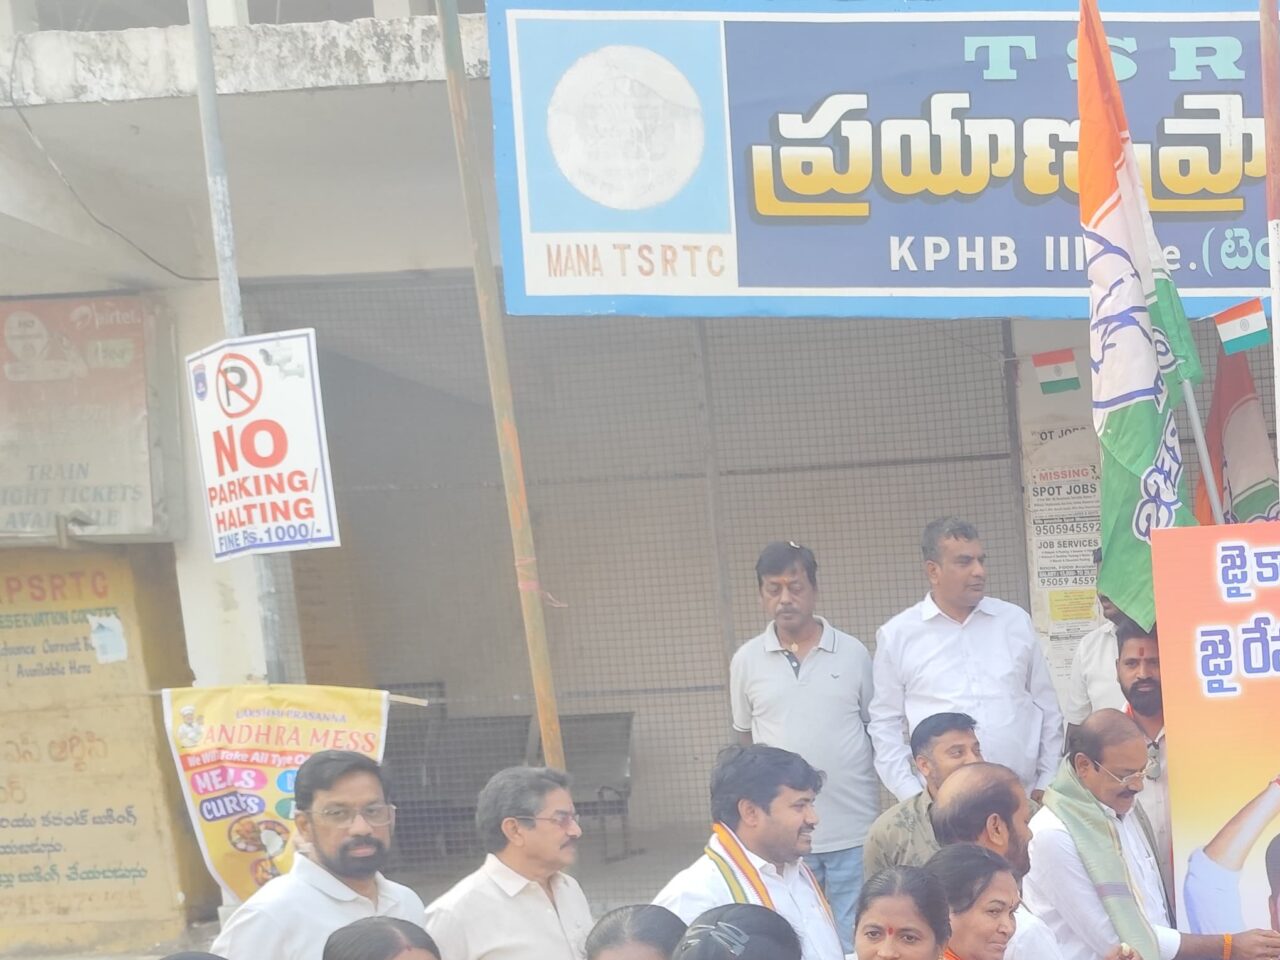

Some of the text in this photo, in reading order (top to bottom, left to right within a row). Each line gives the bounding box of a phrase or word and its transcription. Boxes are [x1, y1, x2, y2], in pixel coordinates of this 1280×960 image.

[546, 242, 725, 278] MANA TSRTC
[889, 236, 1019, 272] KPHB
[212, 419, 288, 478] NO
[27, 462, 90, 481] TRAIN
[1039, 468, 1090, 481] MISSING
[0, 484, 143, 505] IGHT TICKETS
[208, 467, 318, 508] PARKING/
[1032, 483, 1097, 497] SPOT JOBS
[6, 508, 121, 530] AVAILE
[215, 497, 316, 534] HALTING
[1035, 522, 1101, 536] 9505945592
[218, 531, 241, 551] FINE
[1038, 539, 1099, 549] JOB SERVICES
[1071, 576, 1098, 585] 4559
[1221, 544, 1252, 598] జై
[0, 570, 109, 605] PSRTC
[1200, 629, 1238, 694] జై
[204, 722, 377, 753] ANDHRA MESS
[218, 750, 249, 762] Take
